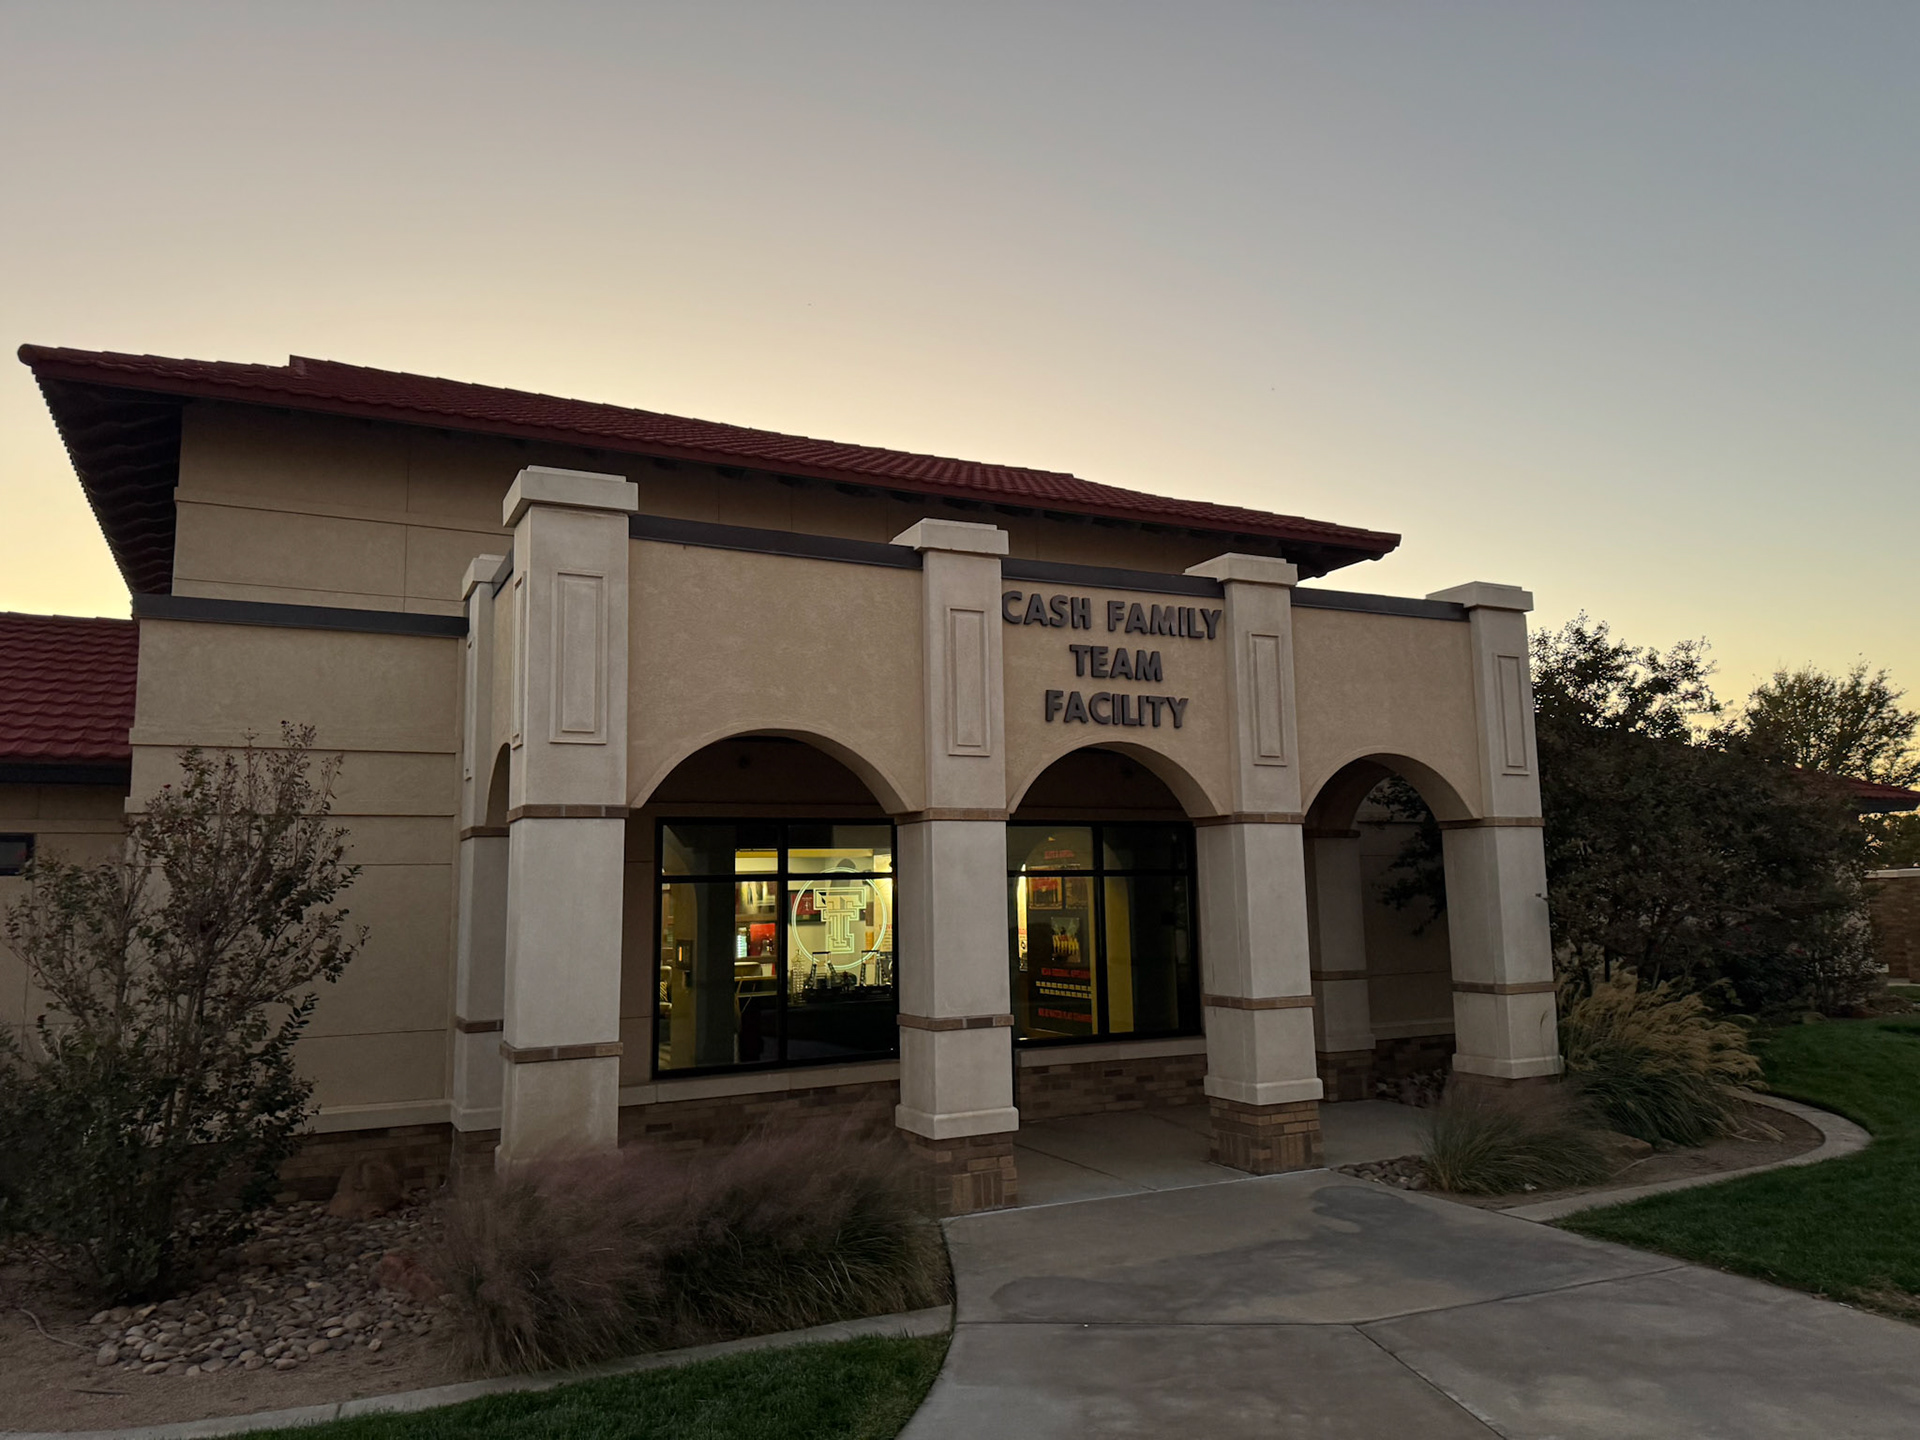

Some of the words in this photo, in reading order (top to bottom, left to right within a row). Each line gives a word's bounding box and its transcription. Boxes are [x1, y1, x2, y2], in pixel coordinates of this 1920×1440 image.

[1001, 590, 1092, 630] CASH
[1107, 600, 1222, 640] FAMILY
[1069, 644, 1163, 682] TEAM
[1045, 689, 1189, 729] FACILITY
